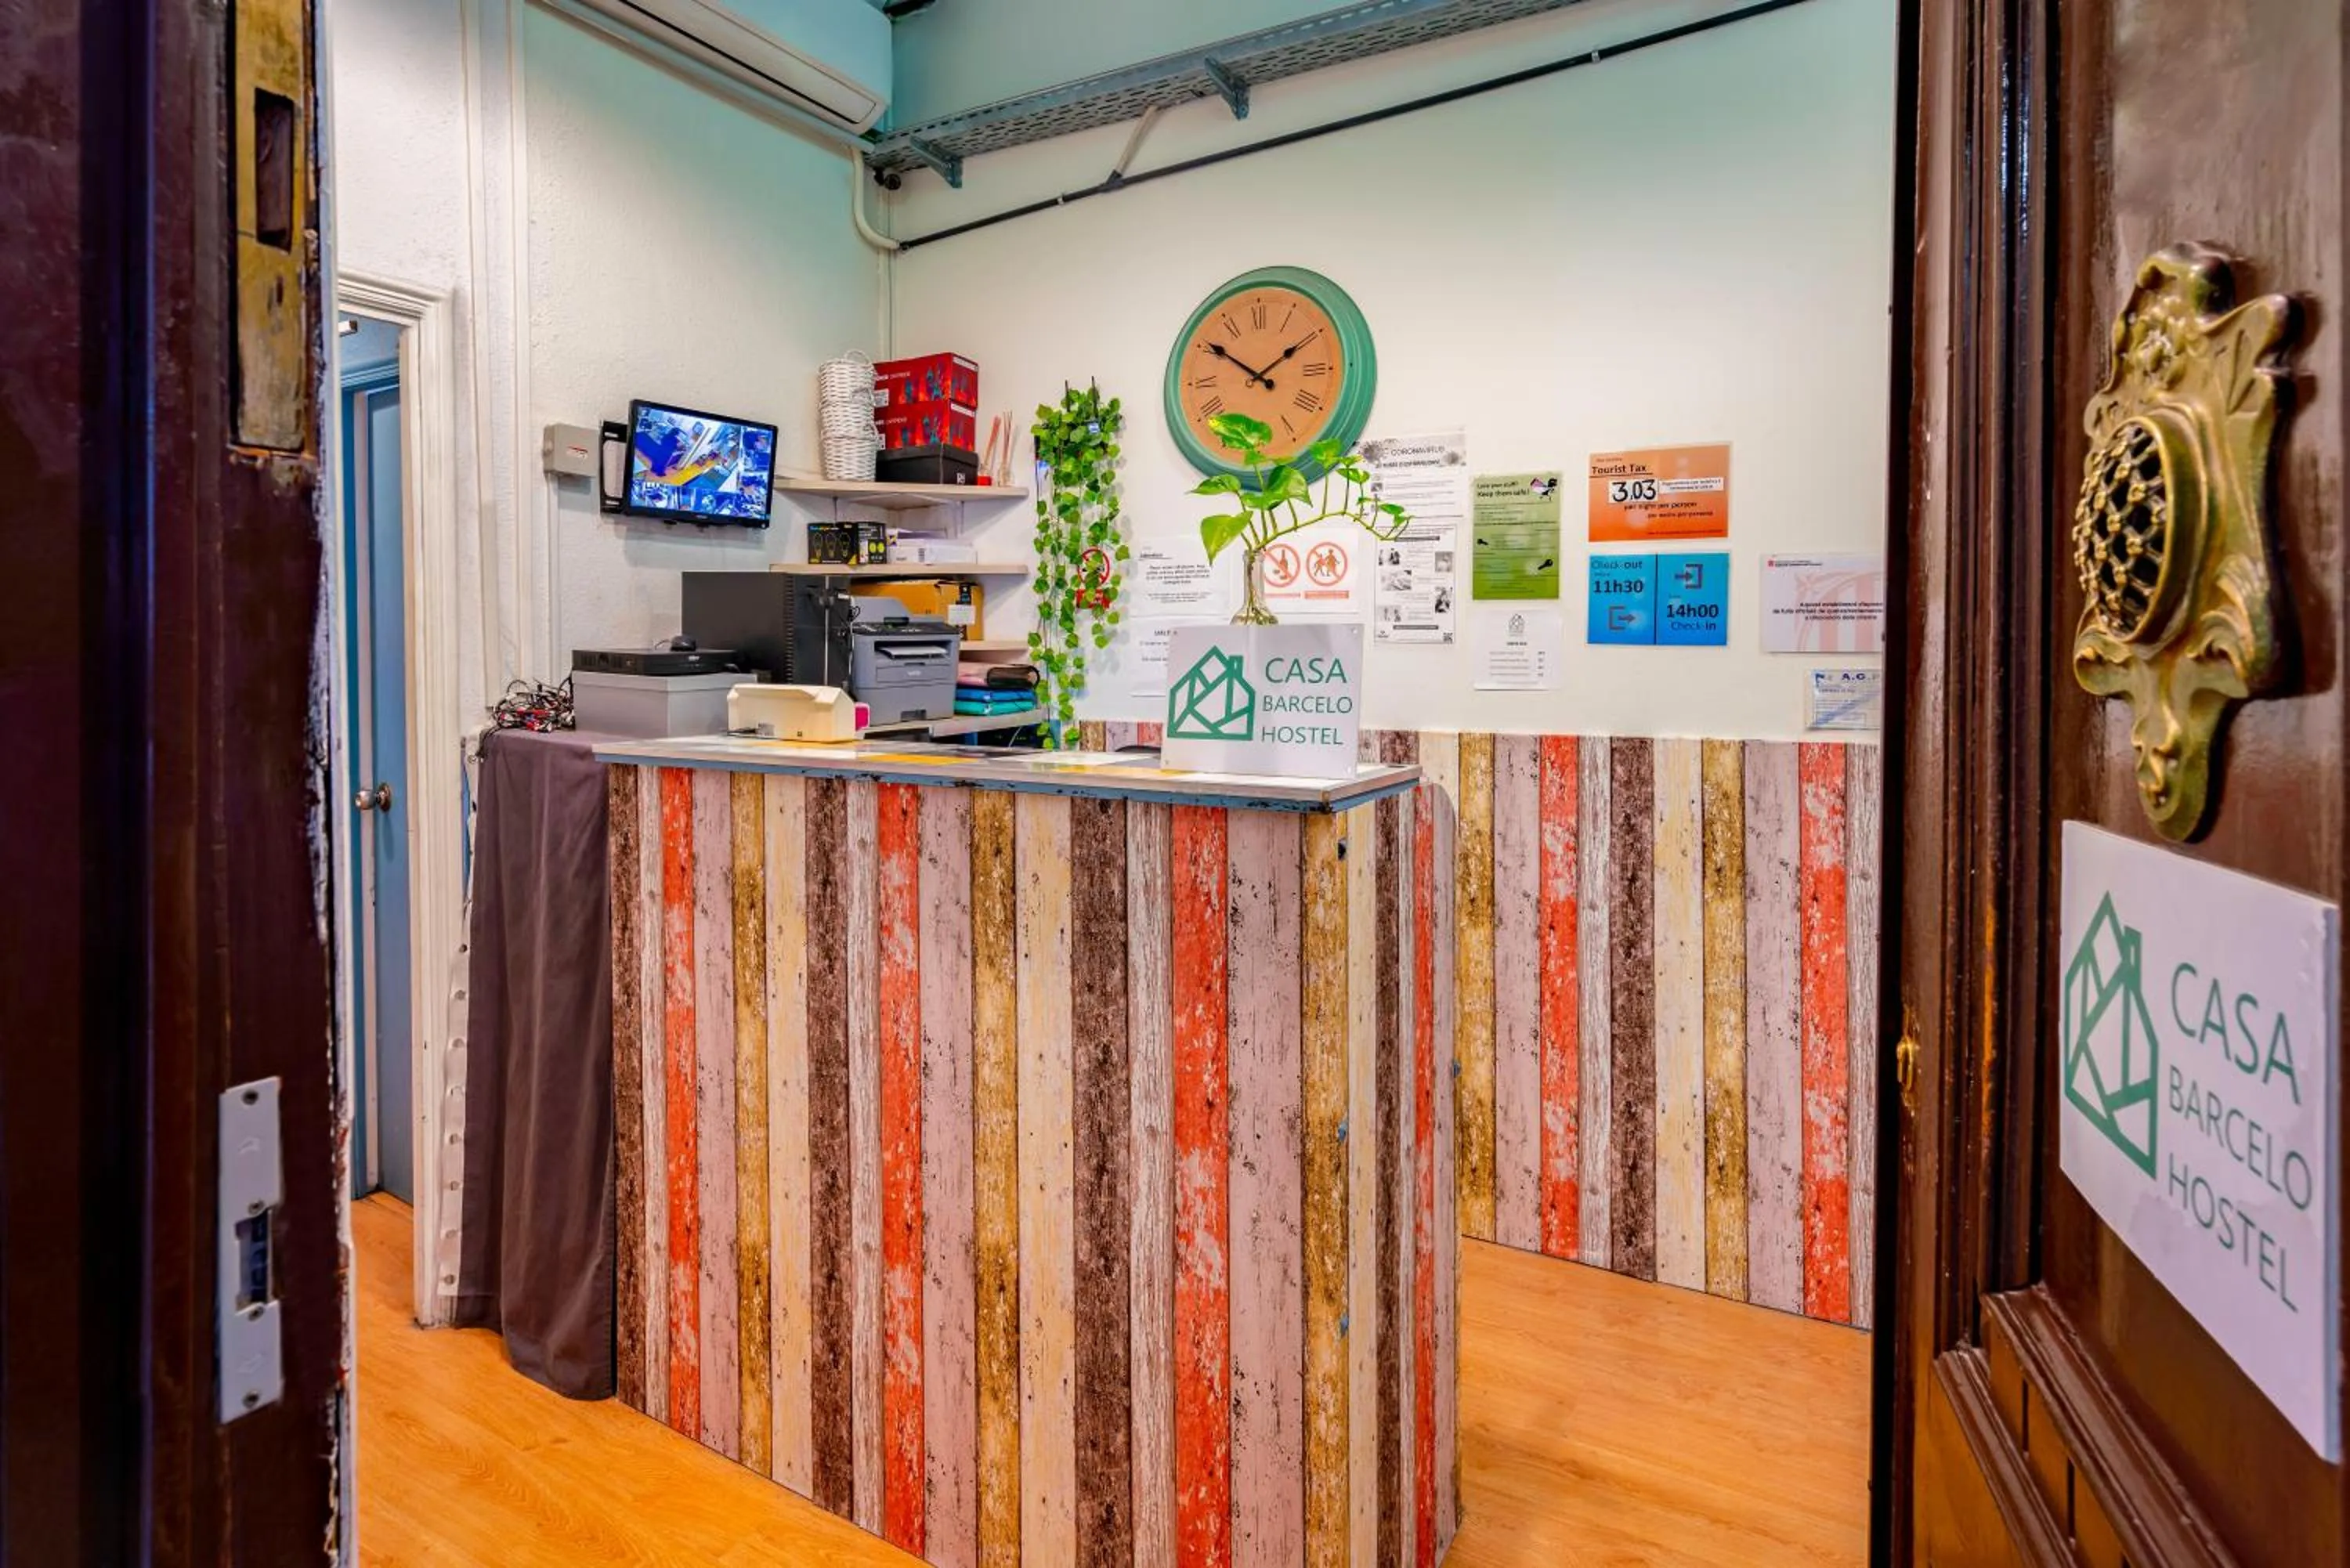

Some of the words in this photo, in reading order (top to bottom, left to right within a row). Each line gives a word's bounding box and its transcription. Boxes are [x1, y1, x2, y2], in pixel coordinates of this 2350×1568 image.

[1591, 464, 1627, 475] Tourist
[1629, 463, 1647, 472] Tax
[1593, 579, 1644, 594] 11h30
[1666, 603, 1719, 618] 14h00
[1265, 657, 1347, 684] CASA
[1263, 695, 1353, 714] BARCELO
[1261, 726, 1344, 745] HOSTEL
[2171, 962, 2301, 1106] CASA
[2169, 1064, 2312, 1211] BARCELO
[2168, 1151, 2299, 1313] HOSTEL
